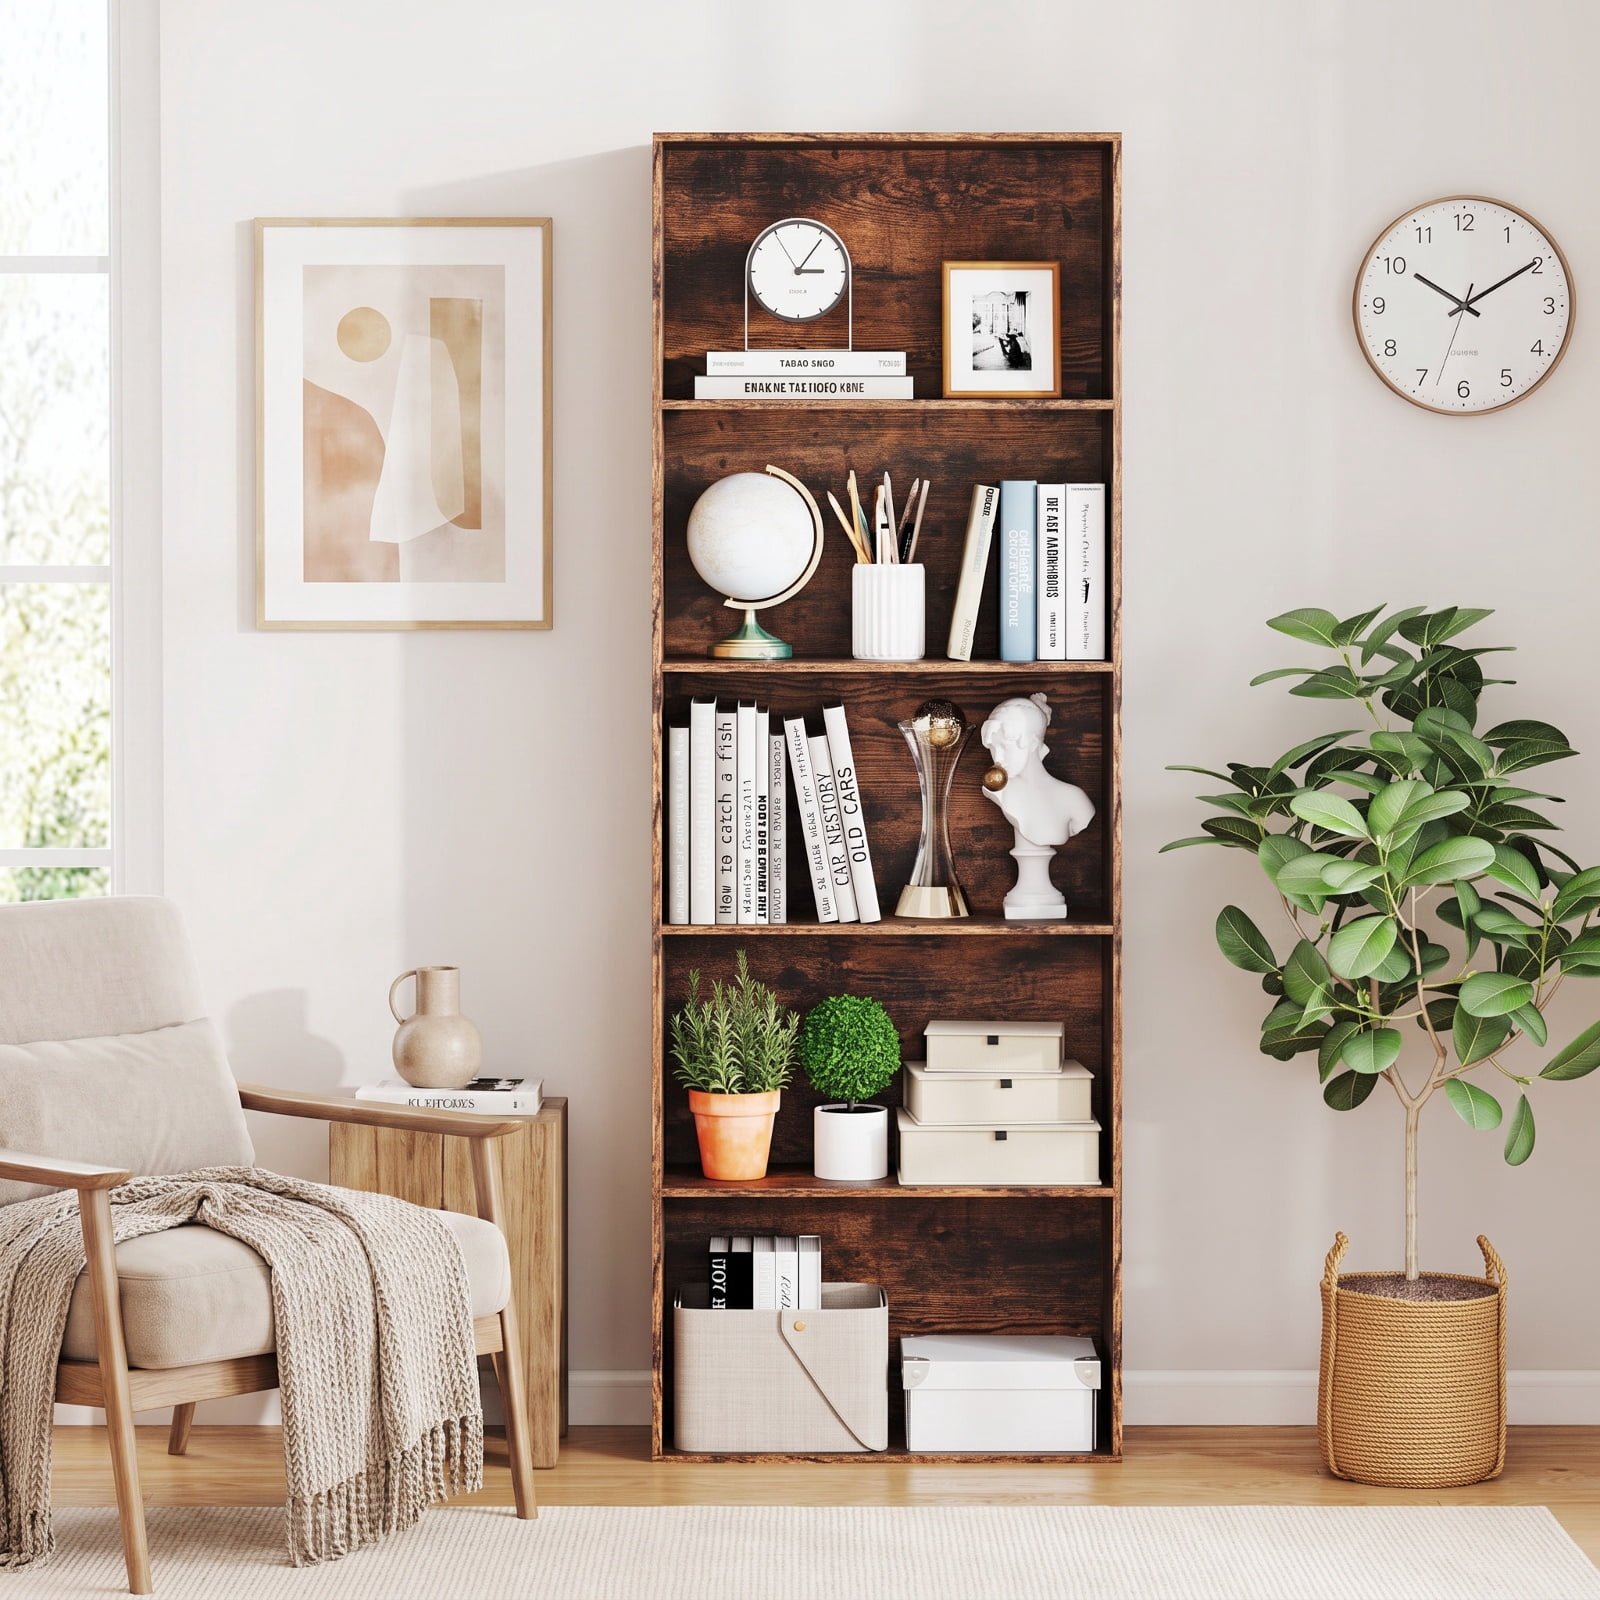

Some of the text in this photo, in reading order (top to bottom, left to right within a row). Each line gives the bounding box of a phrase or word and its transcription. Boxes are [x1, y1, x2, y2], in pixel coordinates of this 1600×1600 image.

[1454, 214, 1474, 231] 12
[1415, 227, 1432, 244] 11
[1504, 227, 1510, 243] 1
[1384, 257, 1406, 274] 10
[1531, 257, 1543, 274] 2
[1373, 297, 1385, 314] 9
[1543, 297, 1555, 314] 3
[1384, 339, 1397, 356] 8
[1530, 339, 1544, 356] 4
[1416, 369, 1428, 386] 7
[1500, 369, 1513, 386] 5
[1457, 380, 1470, 398] 6
[715, 722, 732, 761] fish
[721, 773, 732, 782] a
[718, 793, 732, 843] catch
[837, 767, 867, 862] OLD CARS
[831, 854, 849, 886] CAR
